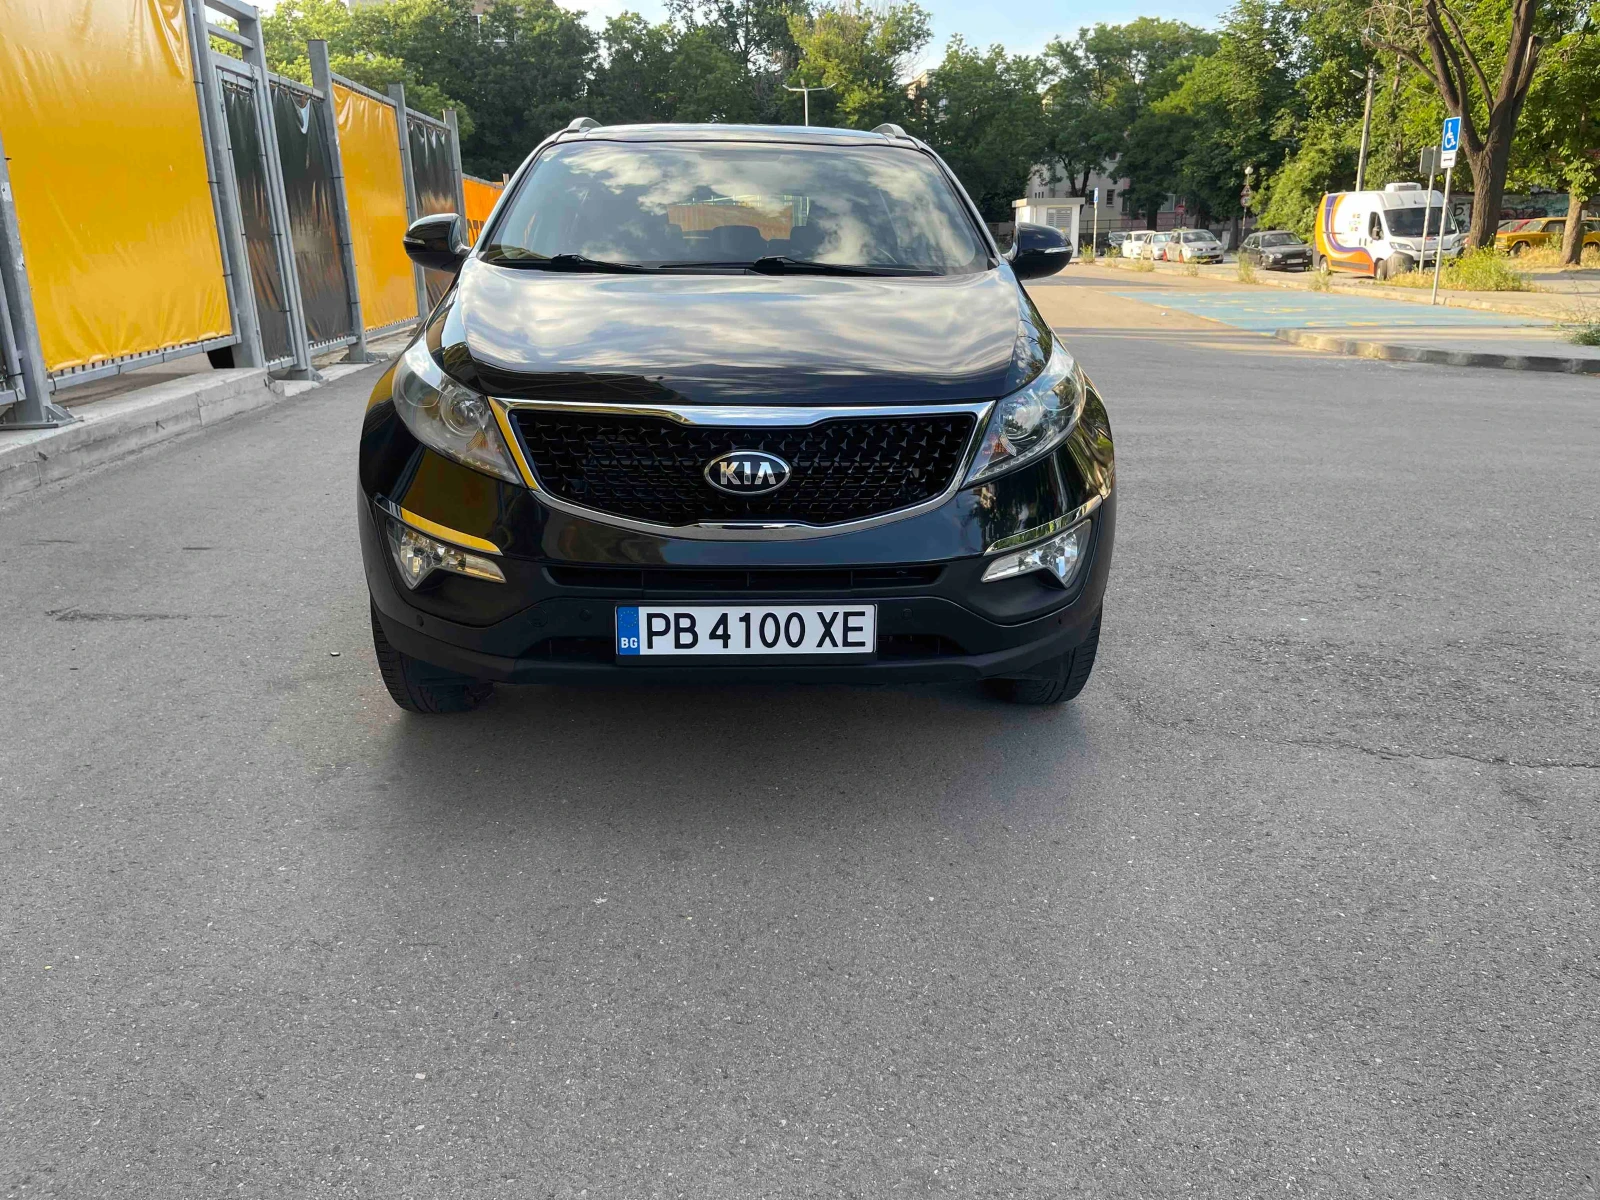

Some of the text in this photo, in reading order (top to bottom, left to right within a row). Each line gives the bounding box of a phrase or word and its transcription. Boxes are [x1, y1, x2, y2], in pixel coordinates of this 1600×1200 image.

[719, 461, 777, 485] KIA
[620, 637, 638, 648] BG
[646, 611, 866, 650] PB 4100 XE
